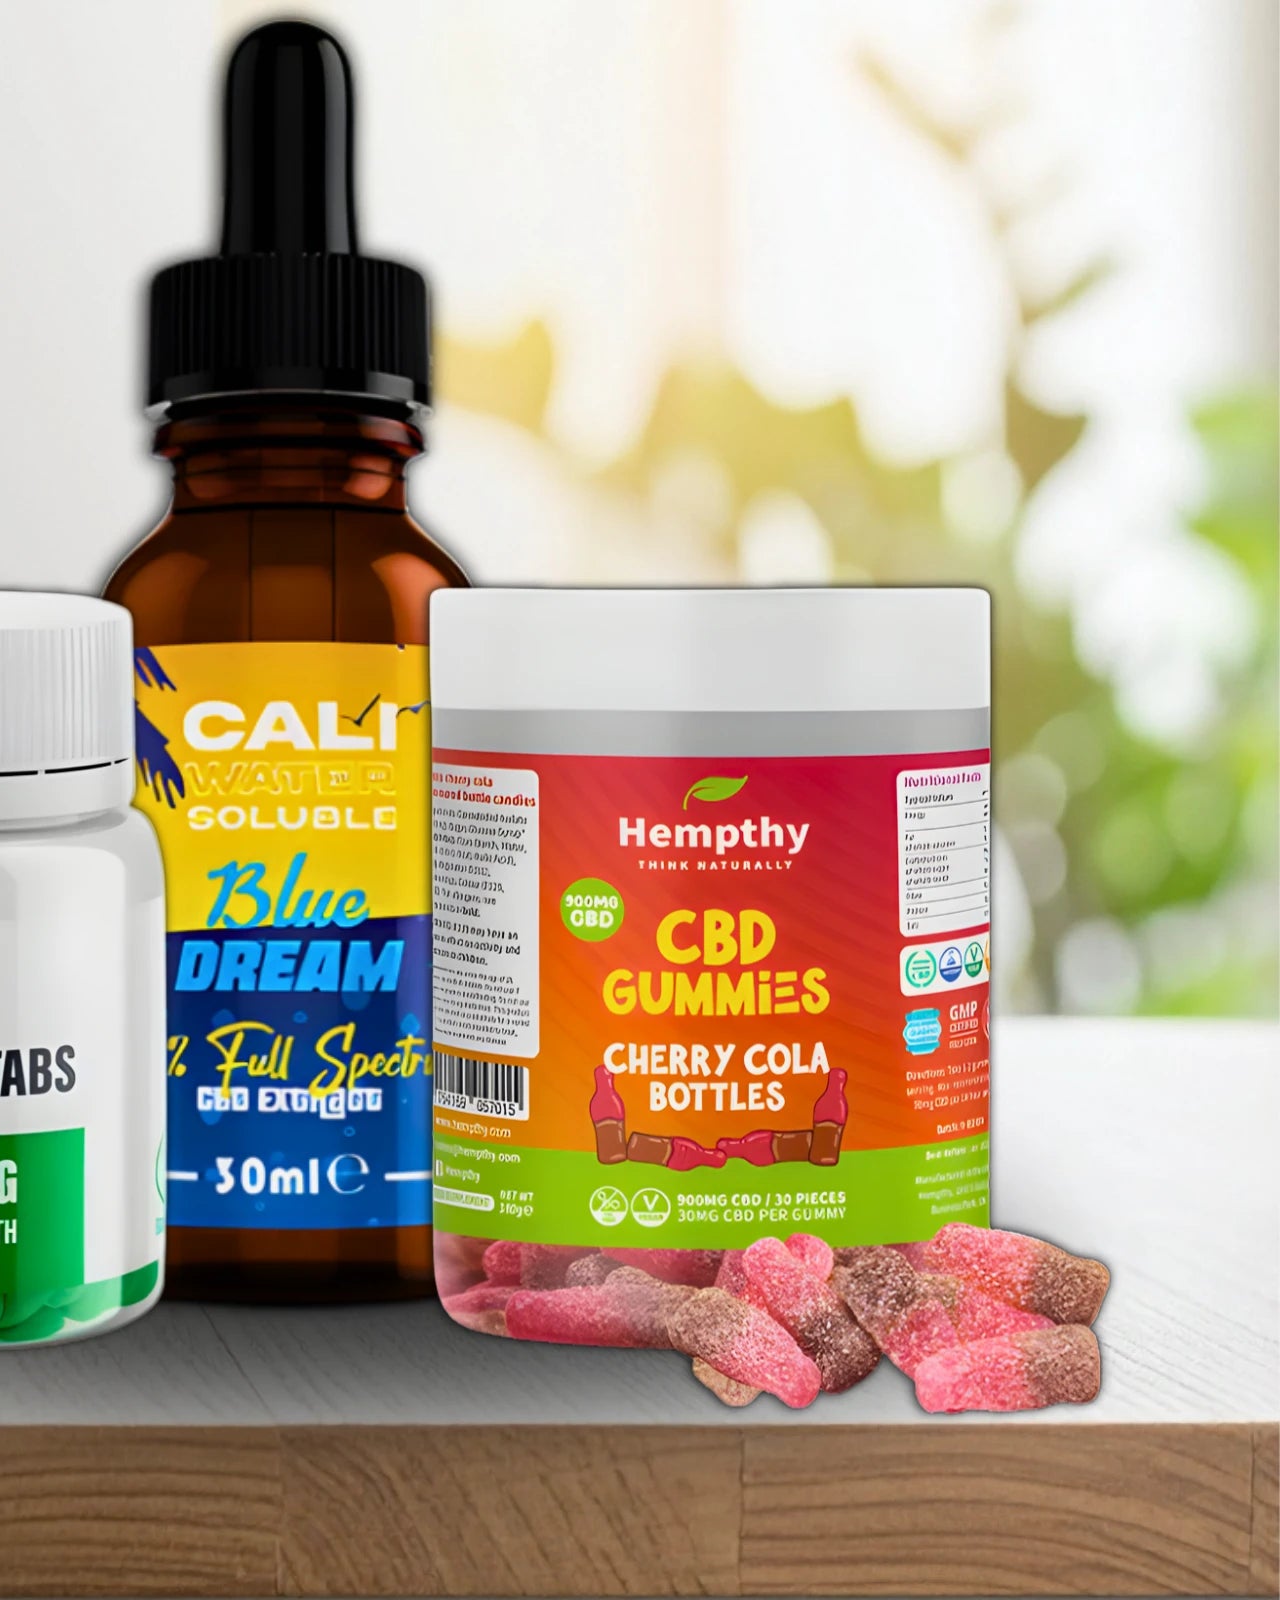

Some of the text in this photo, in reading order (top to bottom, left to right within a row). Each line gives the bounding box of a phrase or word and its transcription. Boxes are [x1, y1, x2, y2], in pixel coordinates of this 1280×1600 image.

[183, 701, 397, 751] CALI
[187, 806, 397, 830] SOLUBLE
[619, 816, 810, 855] Hempthy
[639, 861, 793, 871] THINK NATURALLY
[207, 852, 370, 929] Blue
[565, 895, 618, 909] 900MG
[570, 910, 614, 929] CBD
[656, 909, 776, 966] CBD
[174, 940, 404, 992] DREAM
[950, 1001, 978, 1020] GMP
[206, 1021, 293, 1098] Full
[603, 1041, 830, 1077] CHERRY COLA
[650, 1081, 785, 1112] BOTTLES
[677, 1194, 727, 1207] 900MG
[731, 1193, 762, 1206] CBD
[775, 1193, 791, 1206] 30
[796, 1192, 846, 1205] PIECES
[723, 1209, 754, 1222] CBD
[759, 1209, 787, 1222] PER
[792, 1207, 846, 1221] GUMMY
